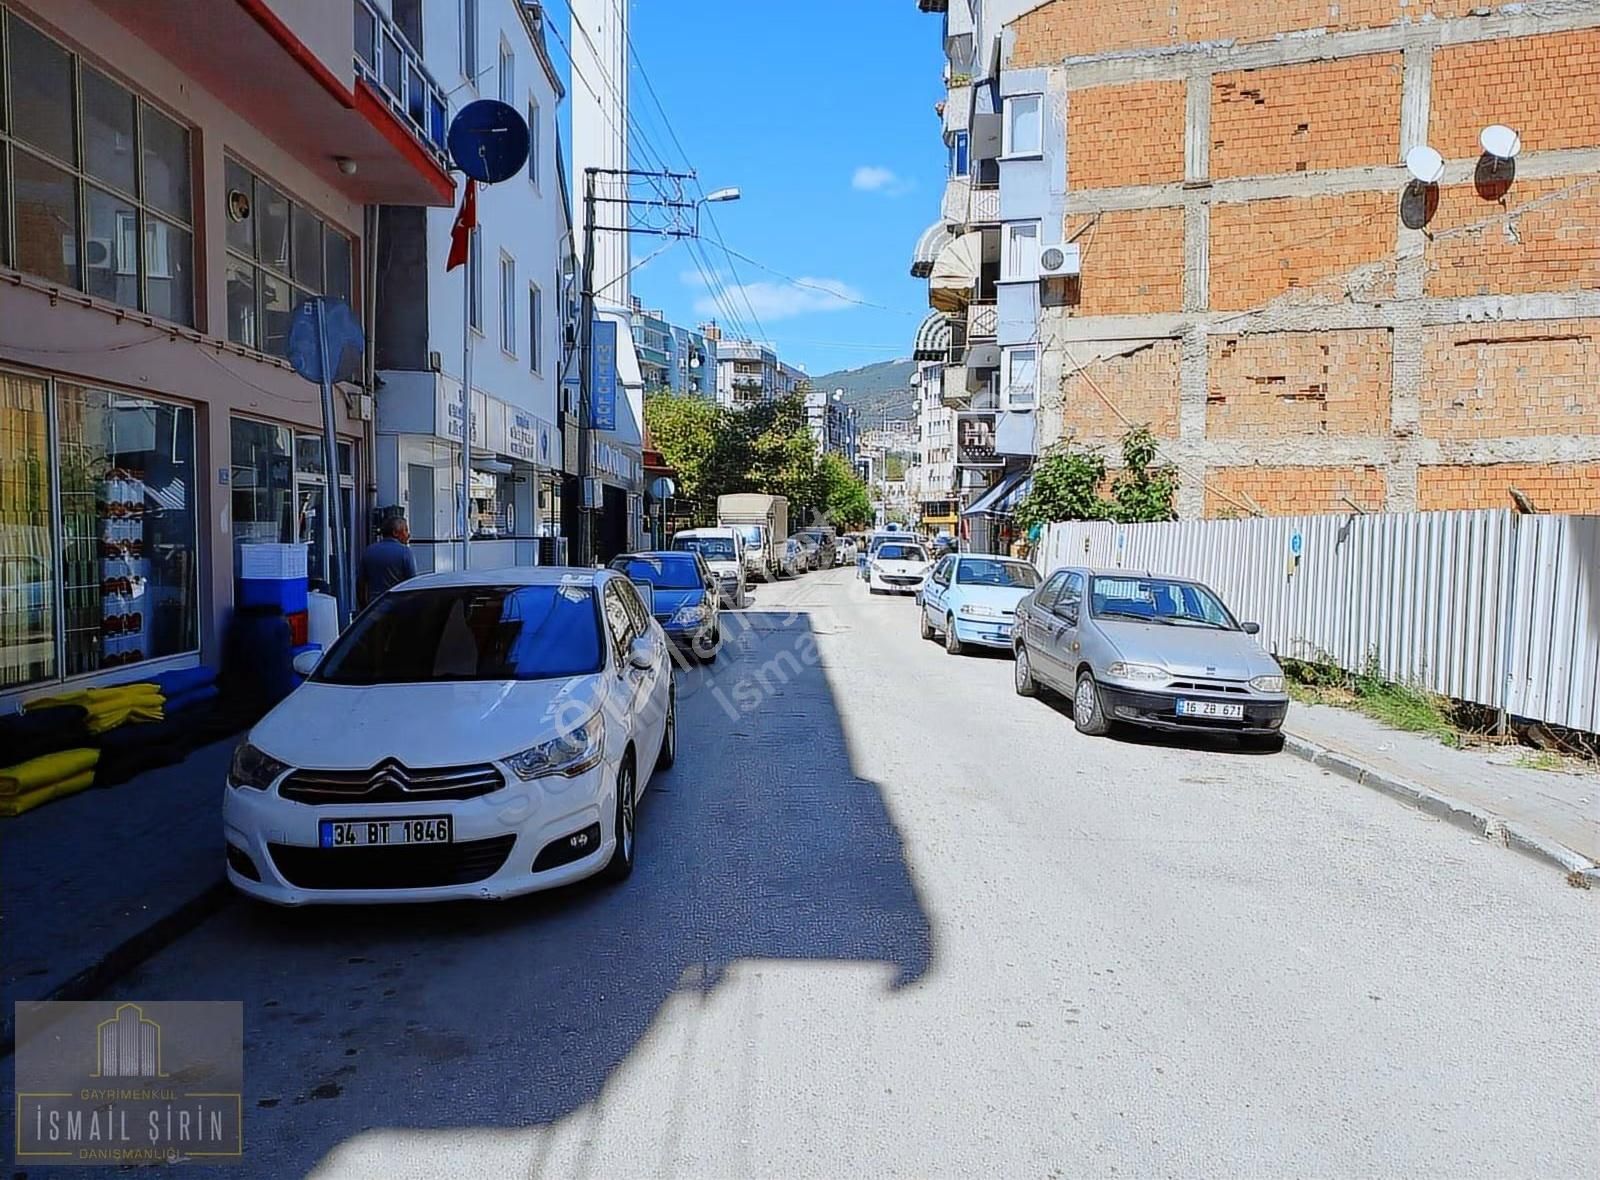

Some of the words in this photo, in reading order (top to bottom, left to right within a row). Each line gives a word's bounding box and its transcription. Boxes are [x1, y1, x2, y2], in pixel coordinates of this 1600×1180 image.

[1186, 702, 1197, 713] 16
[1223, 705, 1241, 716] 671
[334, 823, 357, 846] 34
[367, 822, 390, 844] BT
[403, 819, 447, 842] 1846
